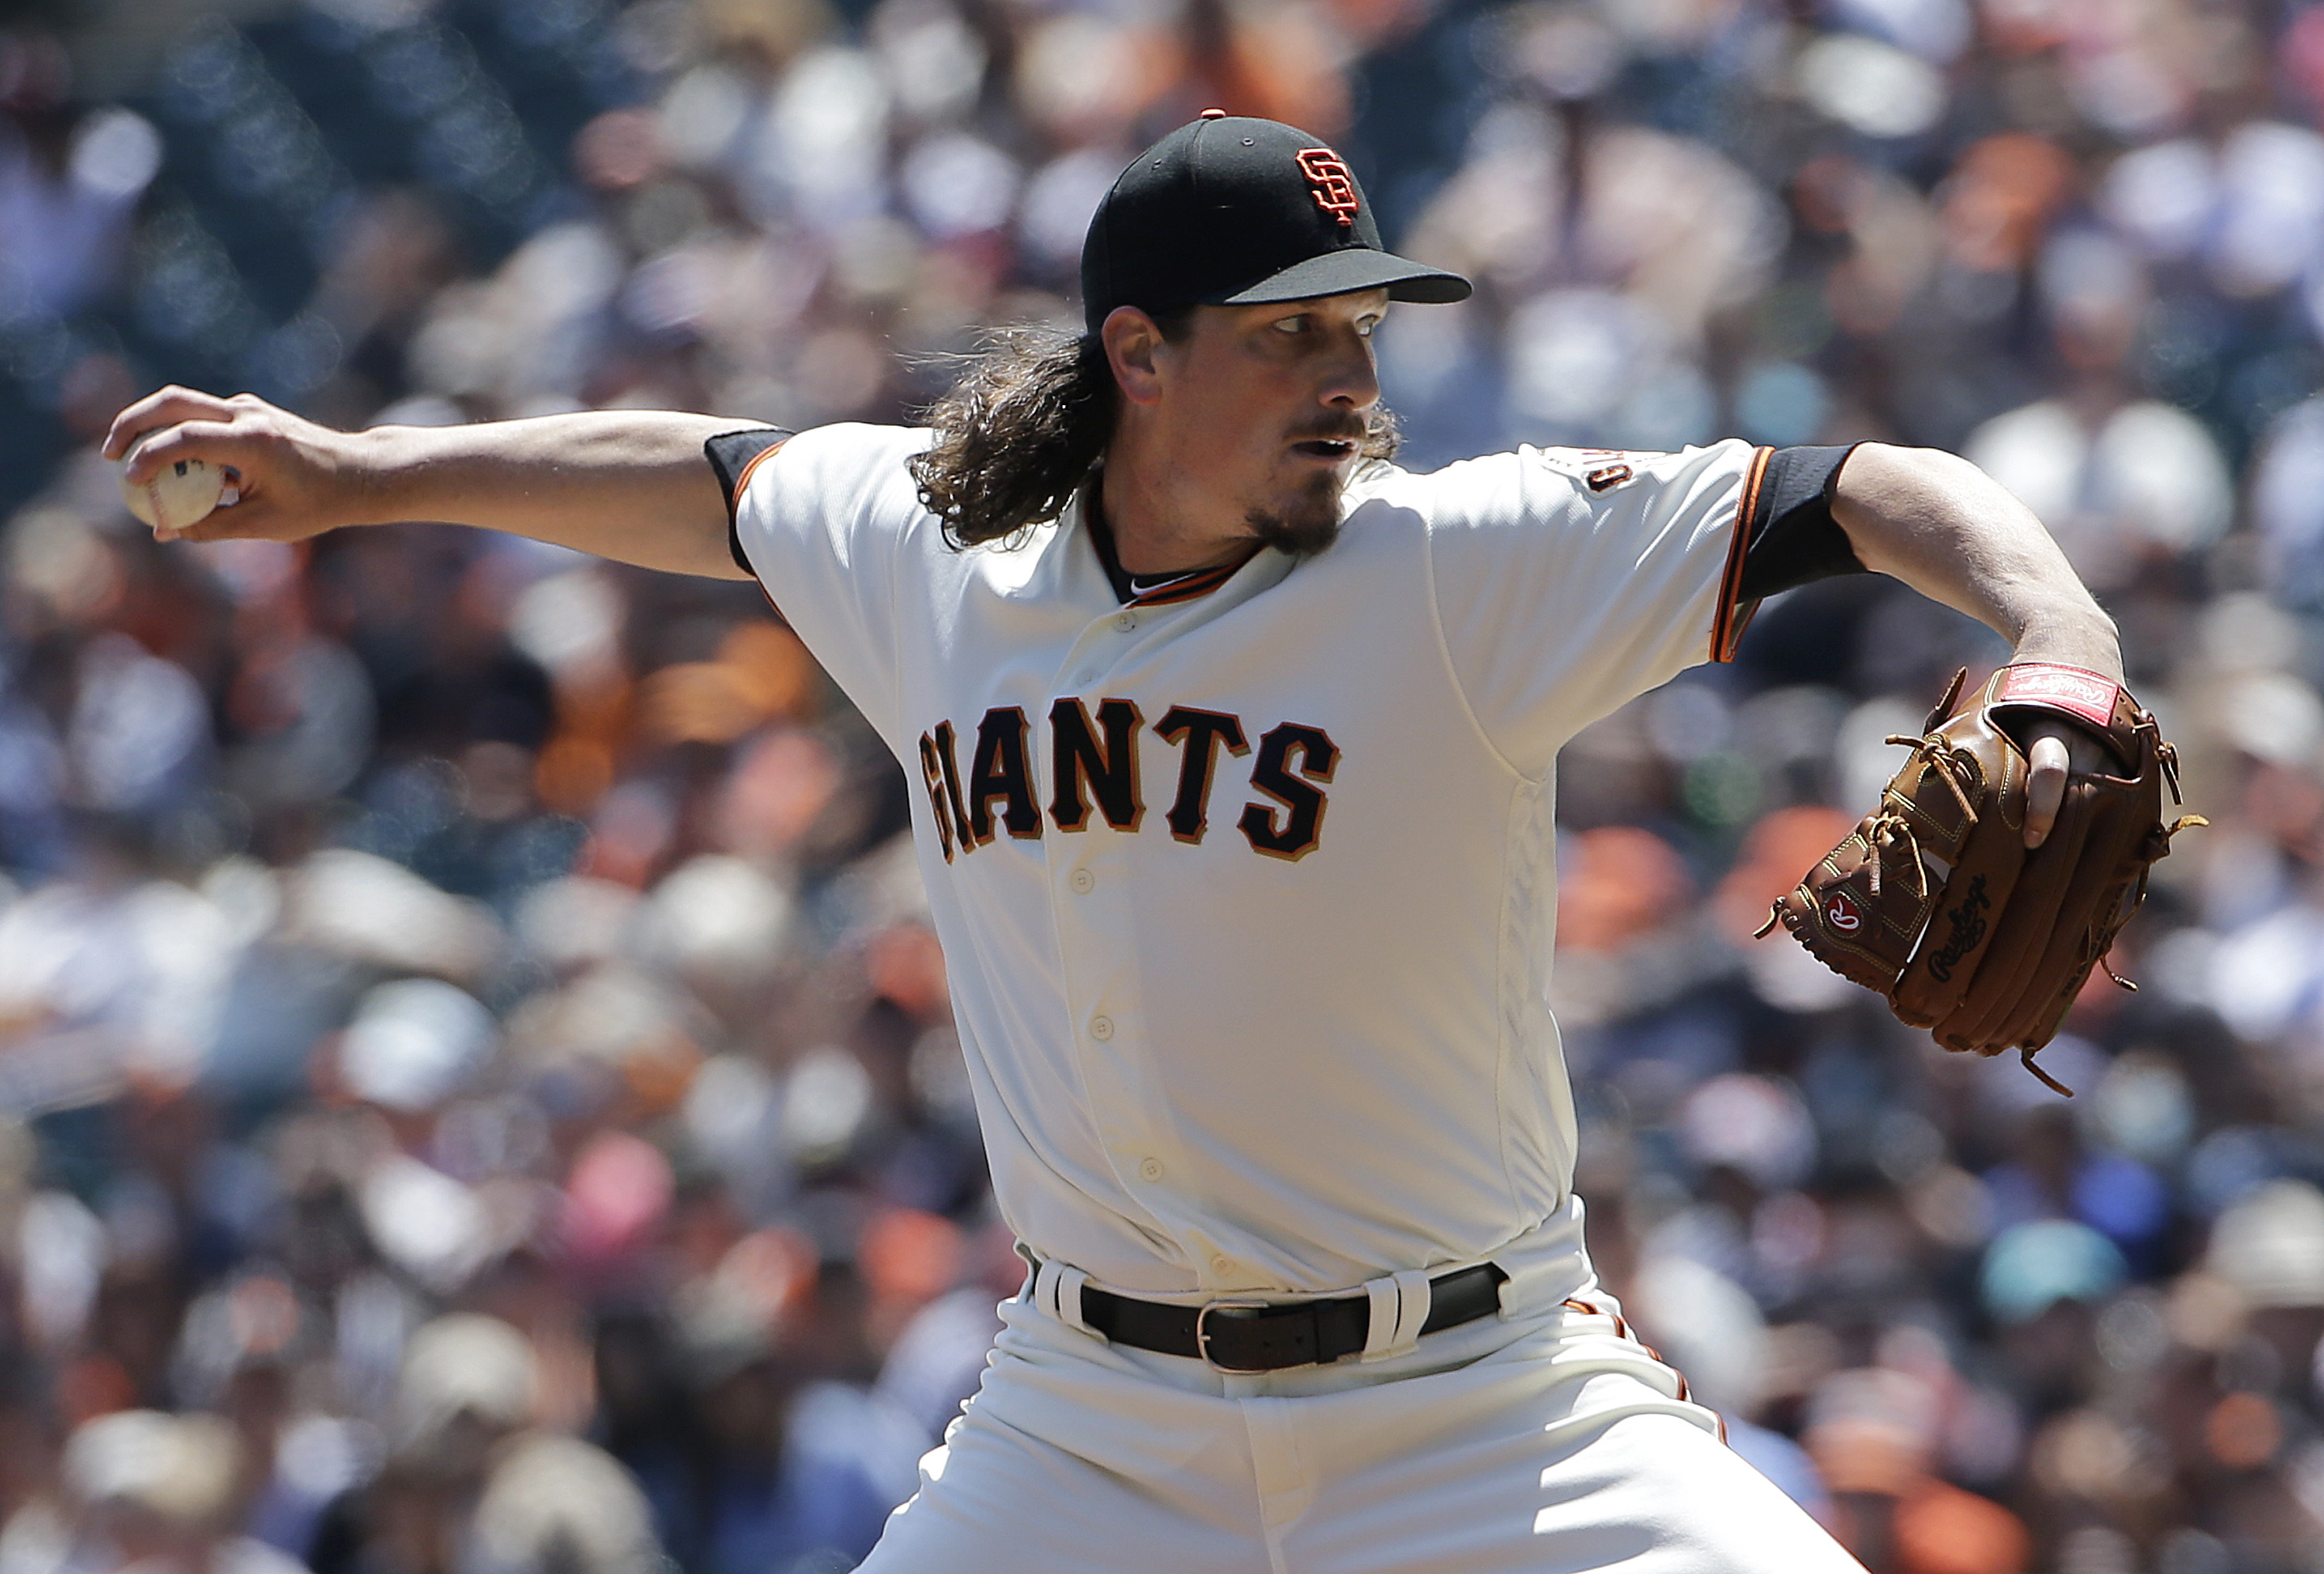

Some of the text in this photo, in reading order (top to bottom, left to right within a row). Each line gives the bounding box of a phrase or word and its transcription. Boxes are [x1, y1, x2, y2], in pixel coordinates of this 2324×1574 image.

[1295, 148, 1360, 226] SF
[918, 696, 1342, 865] GIANTS
[1829, 899, 1860, 930] R
